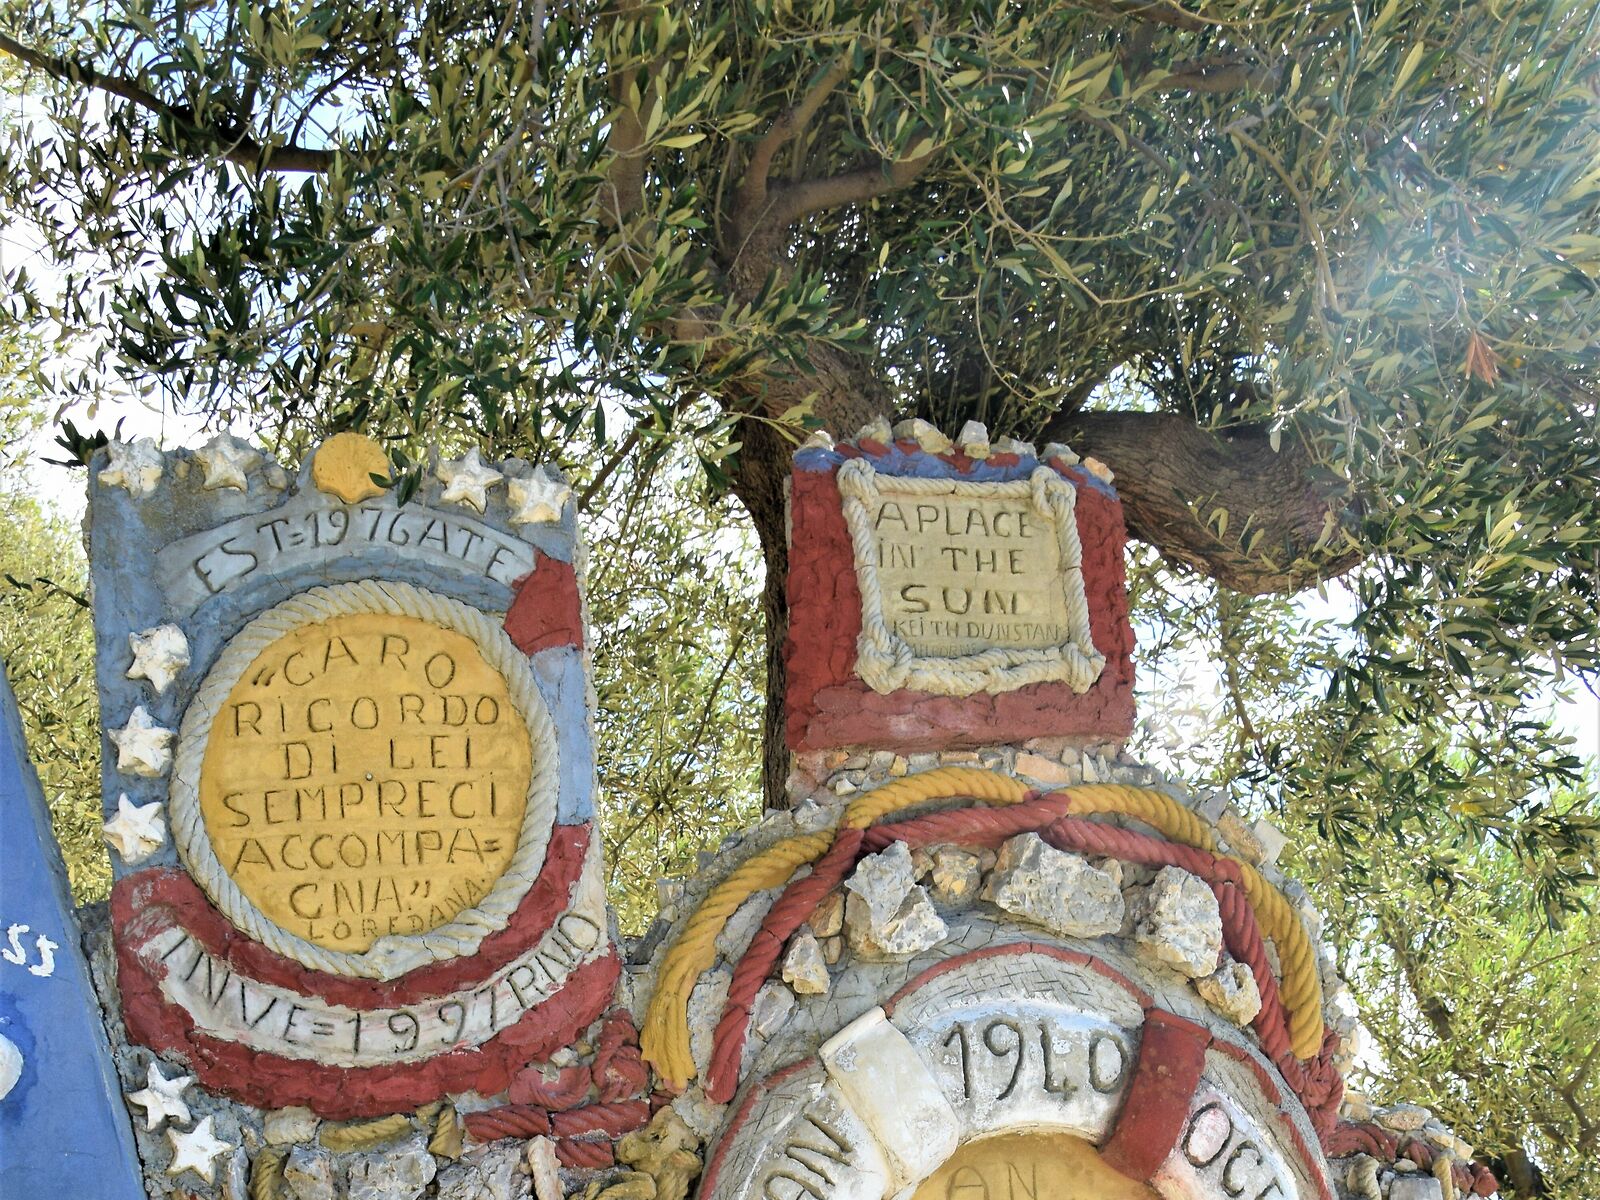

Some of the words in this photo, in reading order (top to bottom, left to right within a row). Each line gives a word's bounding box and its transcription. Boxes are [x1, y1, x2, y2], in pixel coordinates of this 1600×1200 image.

[940, 546, 1027, 575] THE
[900, 583, 1019, 616] SUN
[893, 616, 960, 639] KEITH
[966, 620, 1061, 643] DUNSTAN
[231, 693, 500, 738] RICORDO
[283, 732, 338, 781] DI
[390, 729, 473, 770] LEI
[944, 1018, 1132, 1100] 1940
